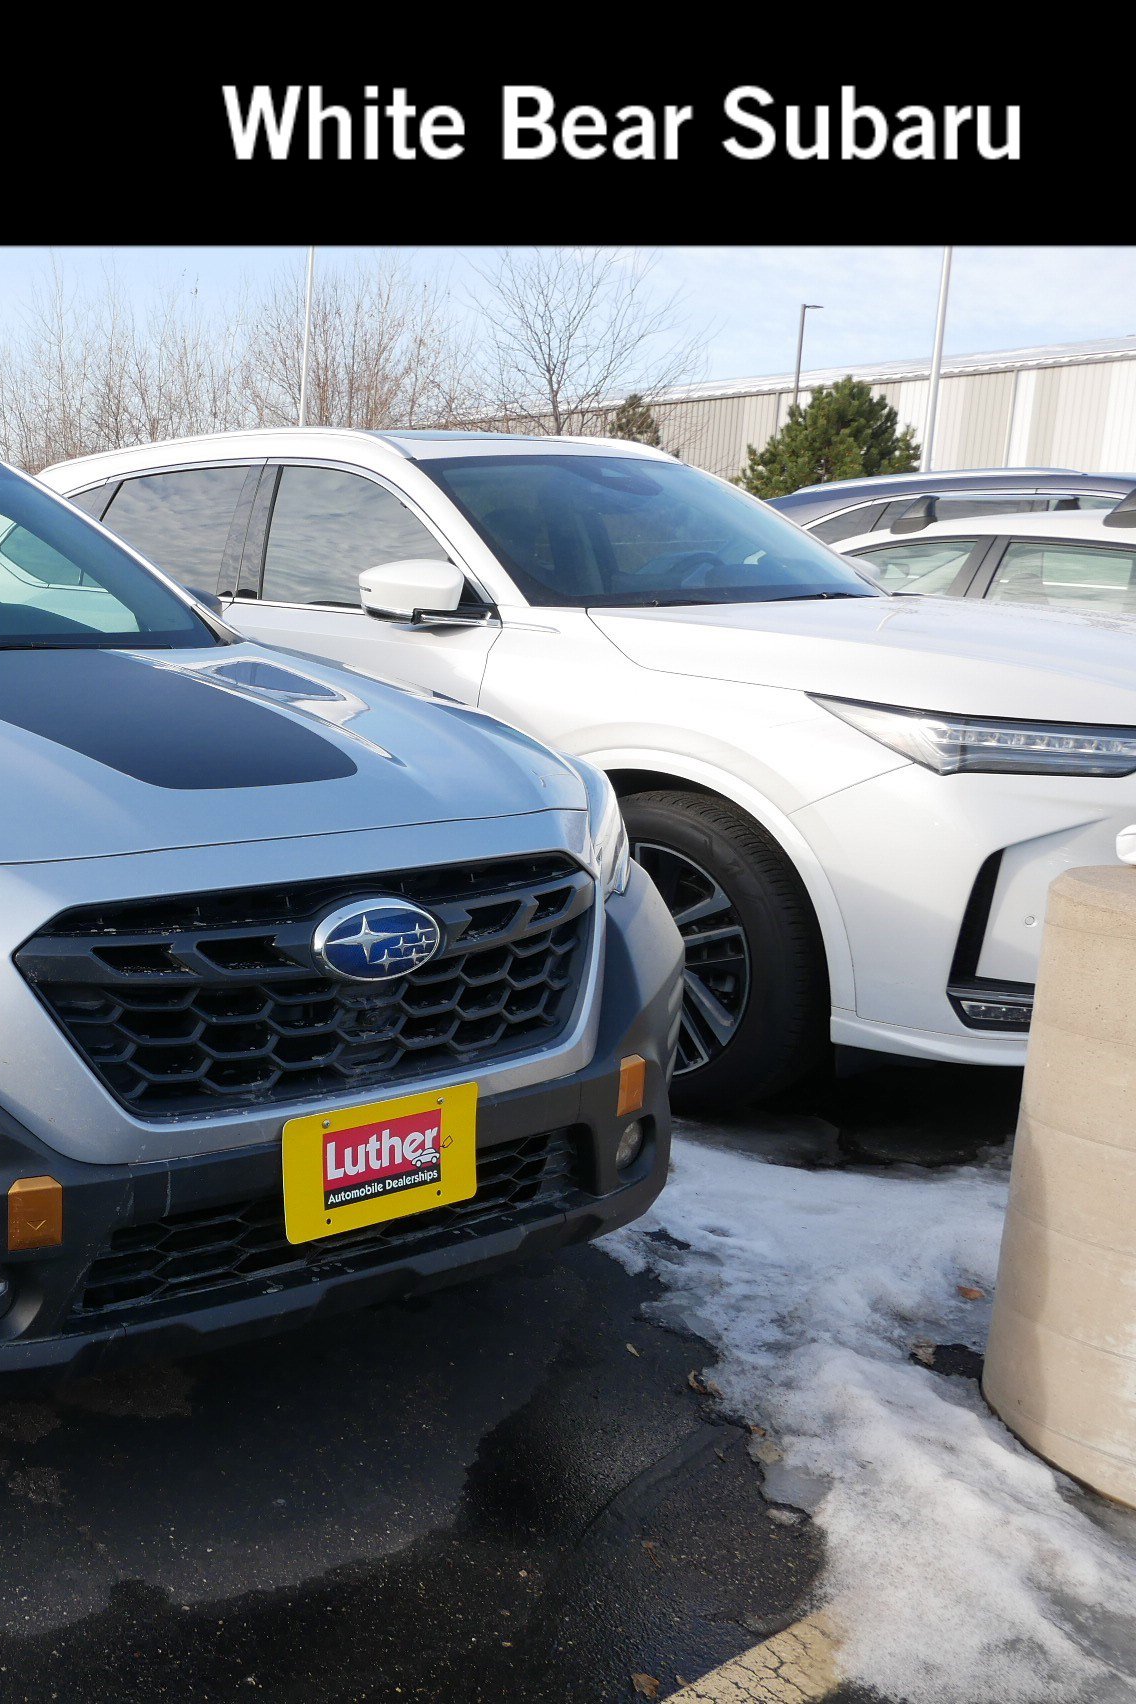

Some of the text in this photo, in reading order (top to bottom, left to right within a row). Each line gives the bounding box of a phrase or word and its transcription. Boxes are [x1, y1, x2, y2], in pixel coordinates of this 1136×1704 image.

[326, 1127, 438, 1180] Luther
[327, 1169, 438, 1204] Automobile Dealerships
